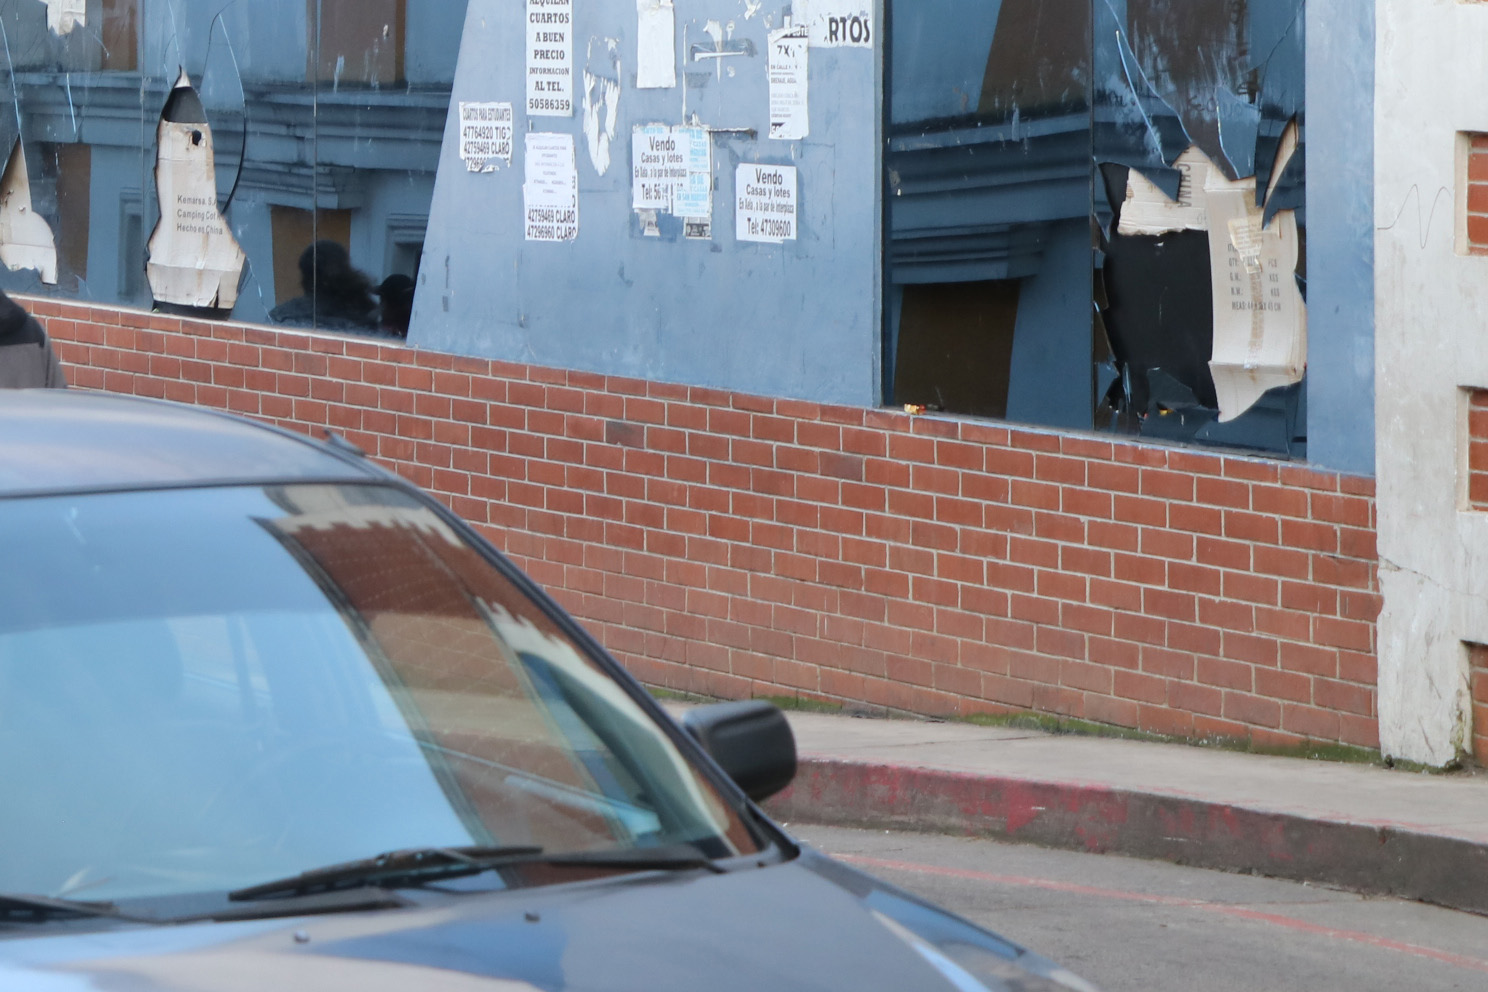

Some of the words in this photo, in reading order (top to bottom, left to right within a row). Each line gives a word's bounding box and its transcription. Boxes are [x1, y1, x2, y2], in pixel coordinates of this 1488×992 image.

[529, 12, 569, 23] CUARTOS
[535, 32, 541, 42] A
[542, 32, 564, 42] BUEN
[533, 50, 565, 60] PRECIO
[529, 67, 569, 75] INFORMACION
[534, 81, 545, 91] AL
[547, 81, 564, 92] TEL.
[529, 98, 570, 110] 50586359
[491, 142, 510, 155] CLARO
[649, 136, 675, 152] Vendo
[641, 152, 660, 163] Casas
[661, 155, 665, 166] y
[667, 152, 683, 163] lotes
[755, 168, 783, 185] Vendo
[641, 183, 652, 200] Tel:
[746, 184, 766, 196] Casas
[768, 188, 772, 199] y
[774, 186, 790, 198] lotes
[1176, 163, 1192, 208] CHINA
[770, 201, 775, 212] de
[528, 209, 554, 223] 42759469
[555, 209, 575, 223] CLARO
[747, 217, 759, 235] Tel:
